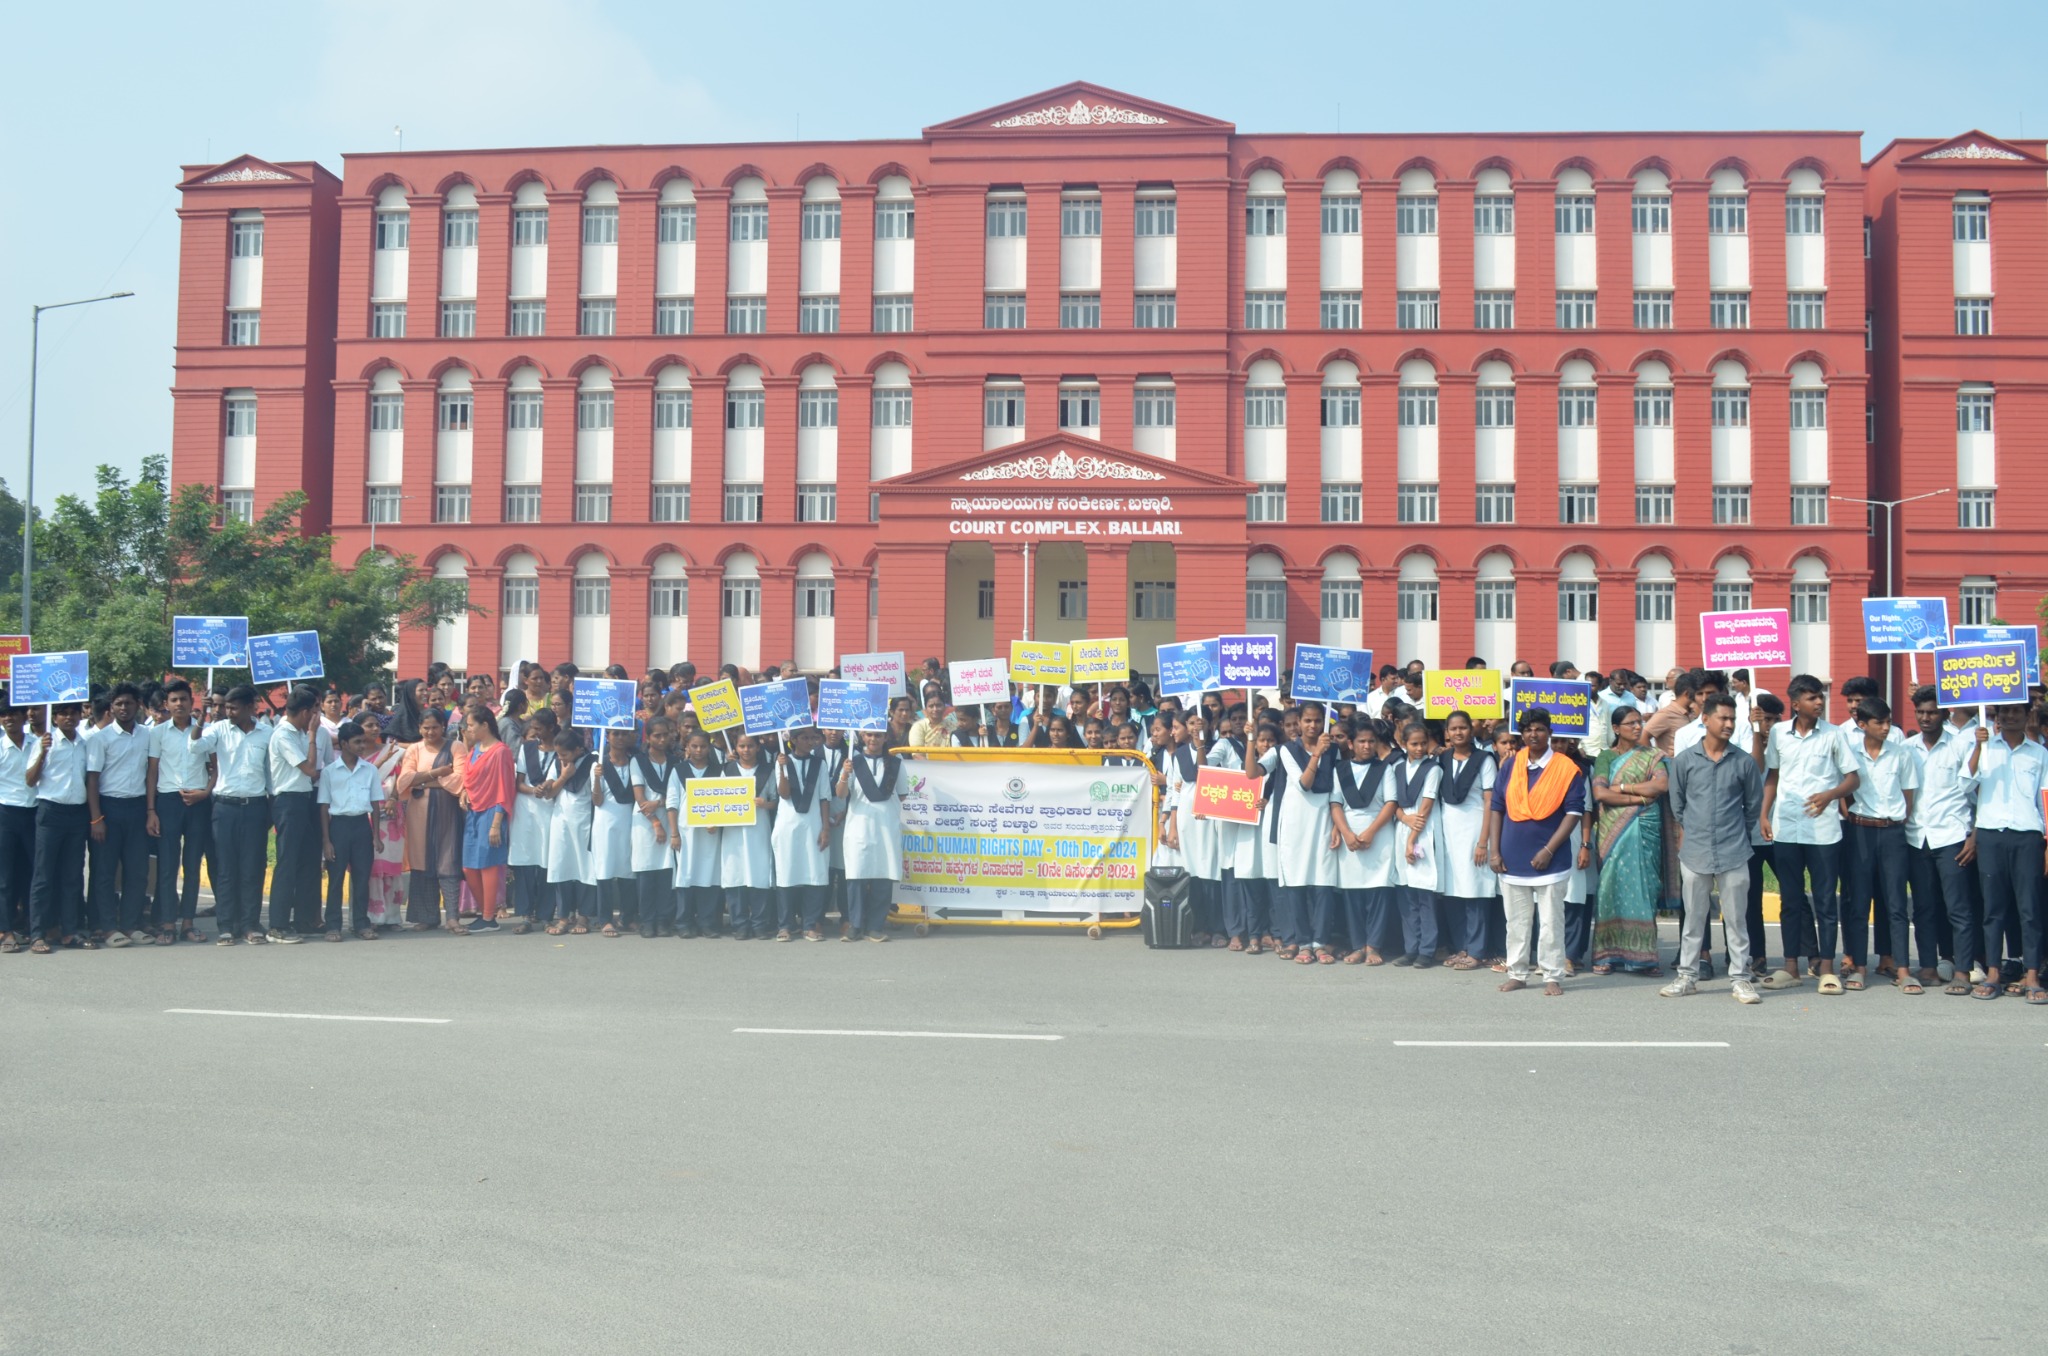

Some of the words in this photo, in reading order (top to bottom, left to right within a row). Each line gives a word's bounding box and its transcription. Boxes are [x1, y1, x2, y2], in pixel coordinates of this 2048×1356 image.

[951, 496, 1054, 514] ನ್ಯಾಯಾಲಯಗಳ
[949, 520, 1006, 535] COURT
[1108, 520, 1183, 535] BALLARI.
[1872, 635, 1887, 643] Right
[1221, 641, 1244, 661] ಮಕ್ಕಳ
[1246, 641, 1273, 661] ಶಿಕ್ಷಣಕ್ಕೆ
[1943, 651, 2016, 671] ಬಾಲಕಾರ್ಮಿಕ
[1431, 695, 1459, 711] ಬಾಲ್ಯ
[1463, 693, 1497, 705] ವಿವಾಹ
[1517, 690, 1536, 708] ಮಕ್ಕಳ
[1539, 691, 1556, 704] ಮೇಲೆ
[1550, 712, 1584, 726] ಾಡಬಾರದು
[1201, 783, 1228, 805] ರಕ್ಷಣೆ
[1232, 787, 1254, 809] ಹಕ್ಕು
[902, 802, 927, 814] ಜಿಲ್ಲಾ
[933, 803, 983, 813] ಕಾನೂನು
[989, 803, 1034, 815] ಸೇವೆಗಳ
[1040, 805, 1091, 818] ಪ್ರಾಧಿಕಾರ
[1097, 807, 1132, 821] ಬಳ್ಳಾರಿ
[1003, 820, 1037, 833] ಬಳ್ಳಾರಿ
[937, 836, 977, 855] HUMAN
[980, 838, 1020, 856] RIGHTS
[1022, 839, 1043, 857] DAY
[1055, 840, 1079, 857] 10th
[1082, 840, 1106, 858] Dec.
[1109, 841, 1137, 858] 2024
[913, 858, 942, 874] ಮಾನವ
[946, 859, 978, 882] ಹಕ್ಕುಗಳ
[982, 860, 1023, 876] ದಿನಾಚರಣೆ
[1037, 861, 1061, 877] 10ನೇ
[1107, 864, 1135, 879] 2024
[929, 886, 971, 894] 10.12.2024
